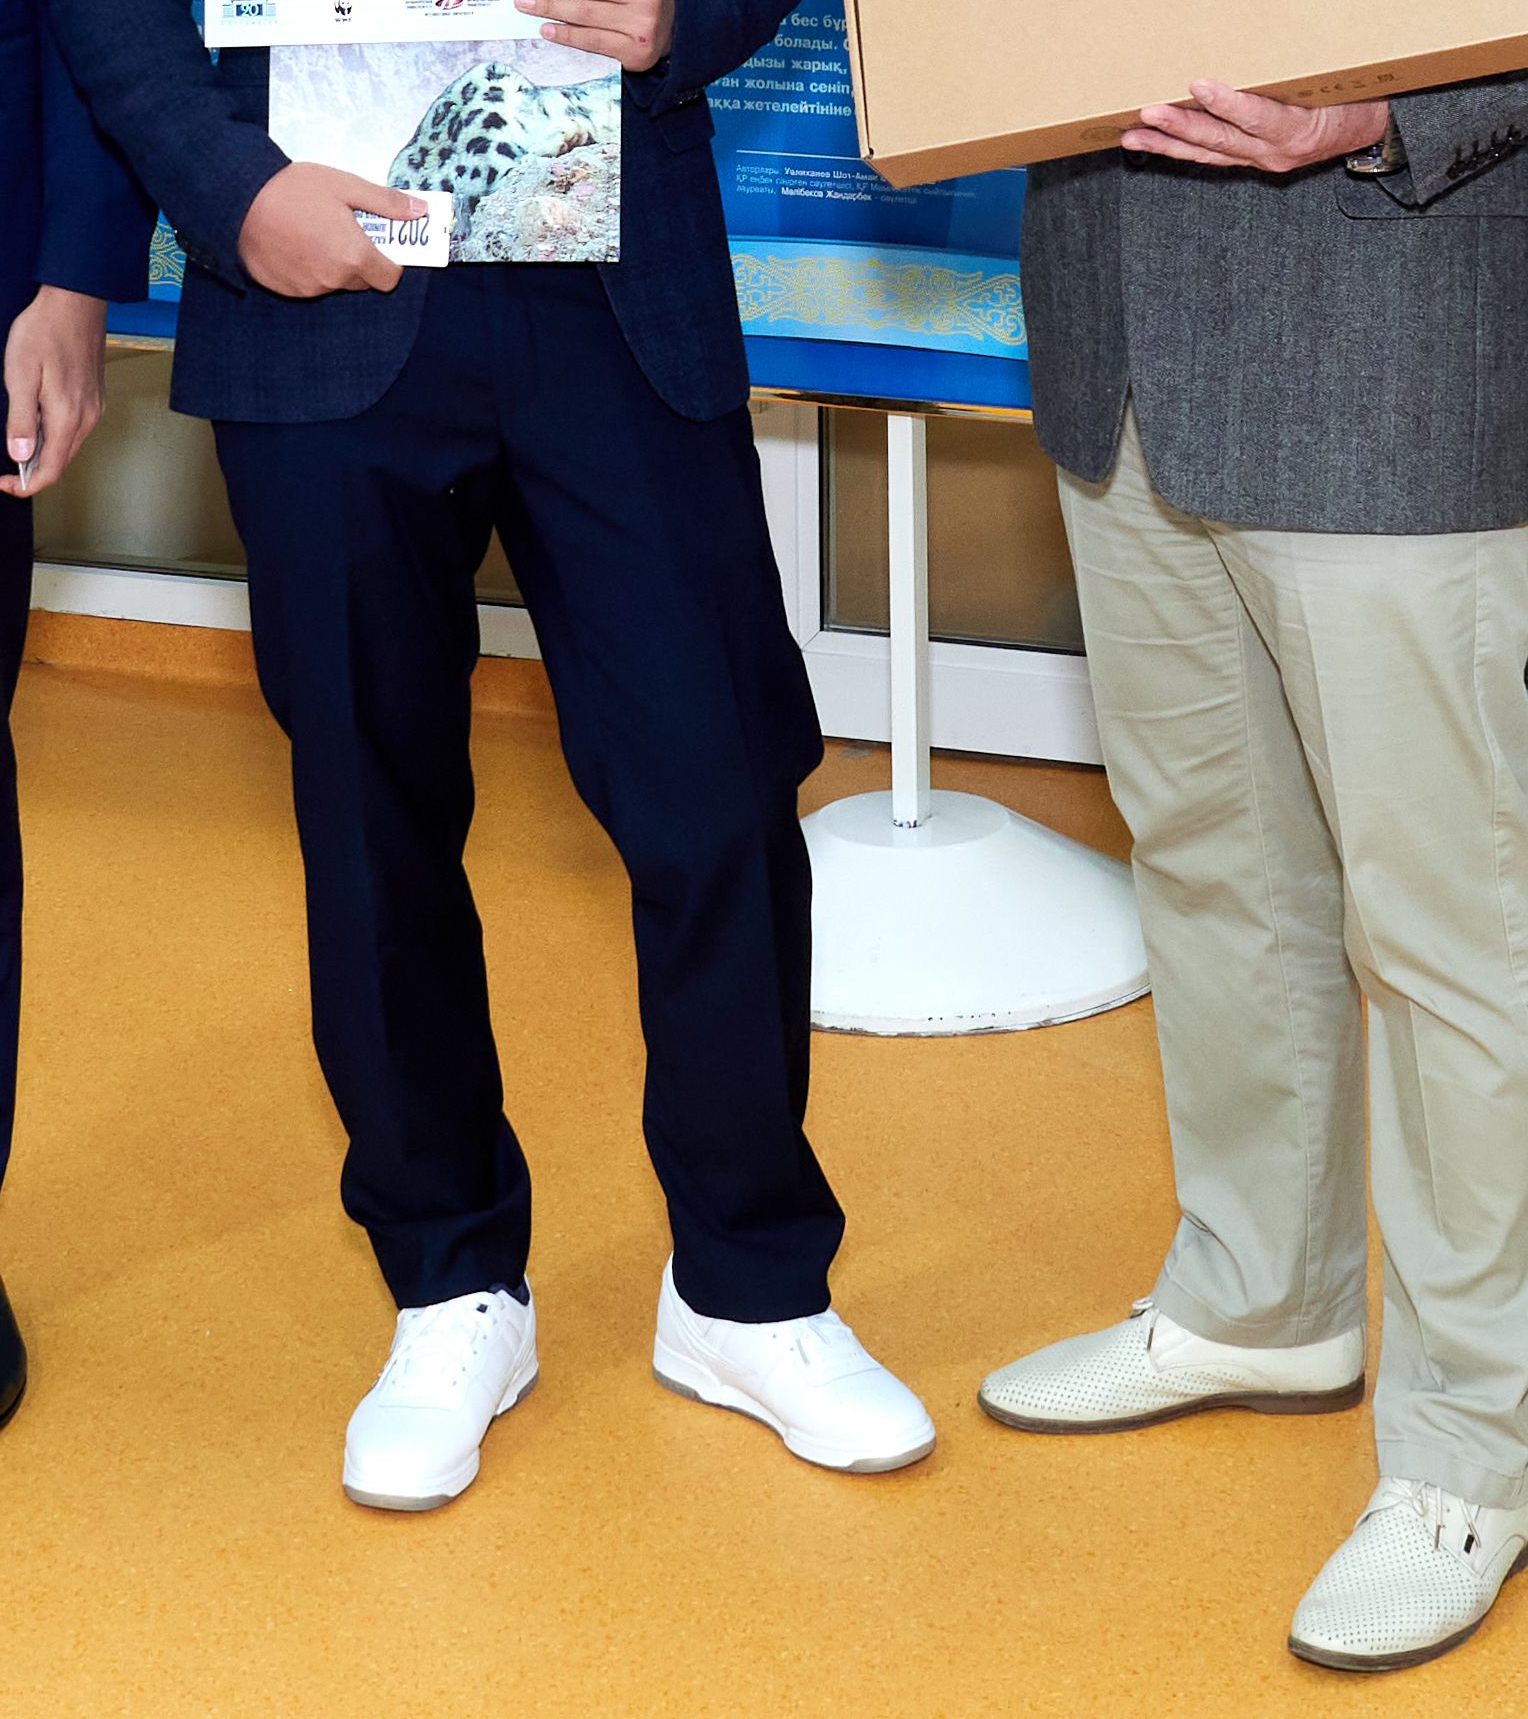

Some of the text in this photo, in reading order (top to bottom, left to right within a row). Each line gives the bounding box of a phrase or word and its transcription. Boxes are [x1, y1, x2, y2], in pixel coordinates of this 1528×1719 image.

[790, 13, 818, 27] бес
[773, 33, 838, 51] болады.
[791, 60, 848, 75] жарық,
[744, 79, 805, 92] жолына
[743, 100, 852, 116] жетелейтініне
[388, 212, 430, 247] 2021
